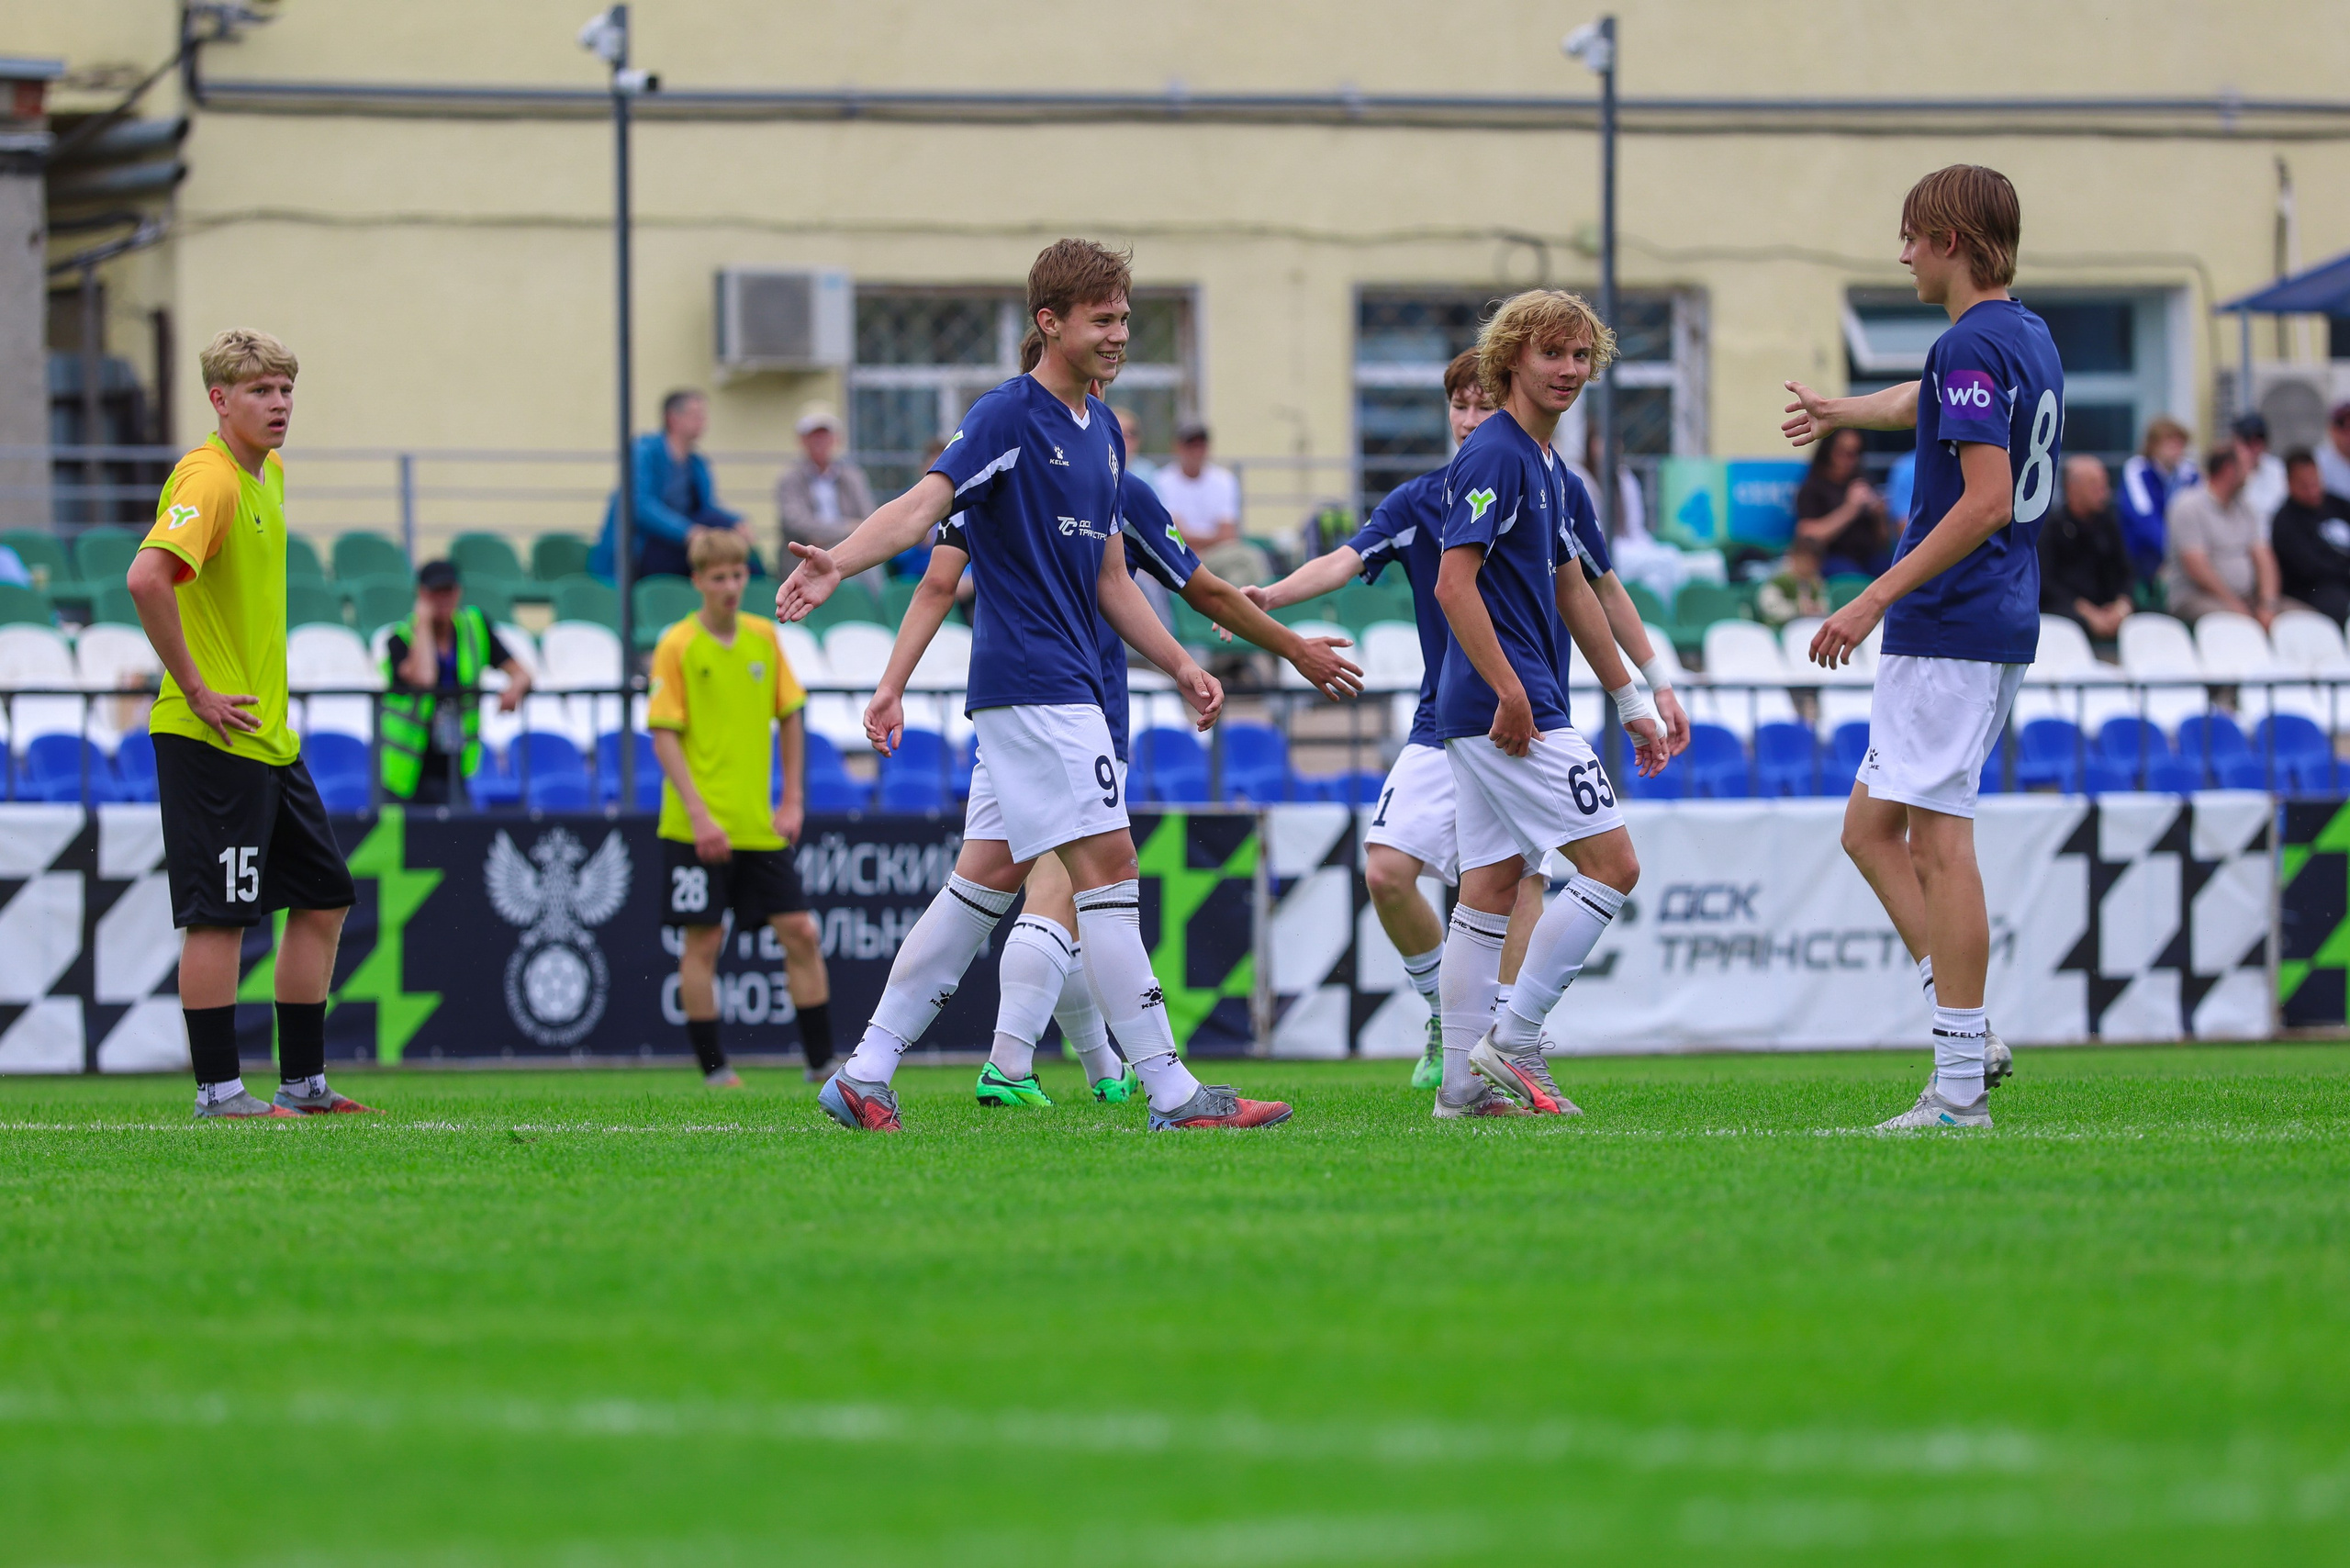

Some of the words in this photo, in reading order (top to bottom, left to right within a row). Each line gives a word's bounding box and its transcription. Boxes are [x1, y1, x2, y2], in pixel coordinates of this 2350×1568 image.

[1947, 380, 1991, 409] wb
[1049, 458, 1070, 467] KELME
[1094, 755, 1119, 809] 9
[1568, 759, 1615, 815] 63
[218, 846, 260, 903] 15
[671, 866, 710, 913] 28
[1658, 882, 1762, 923] ДСК
